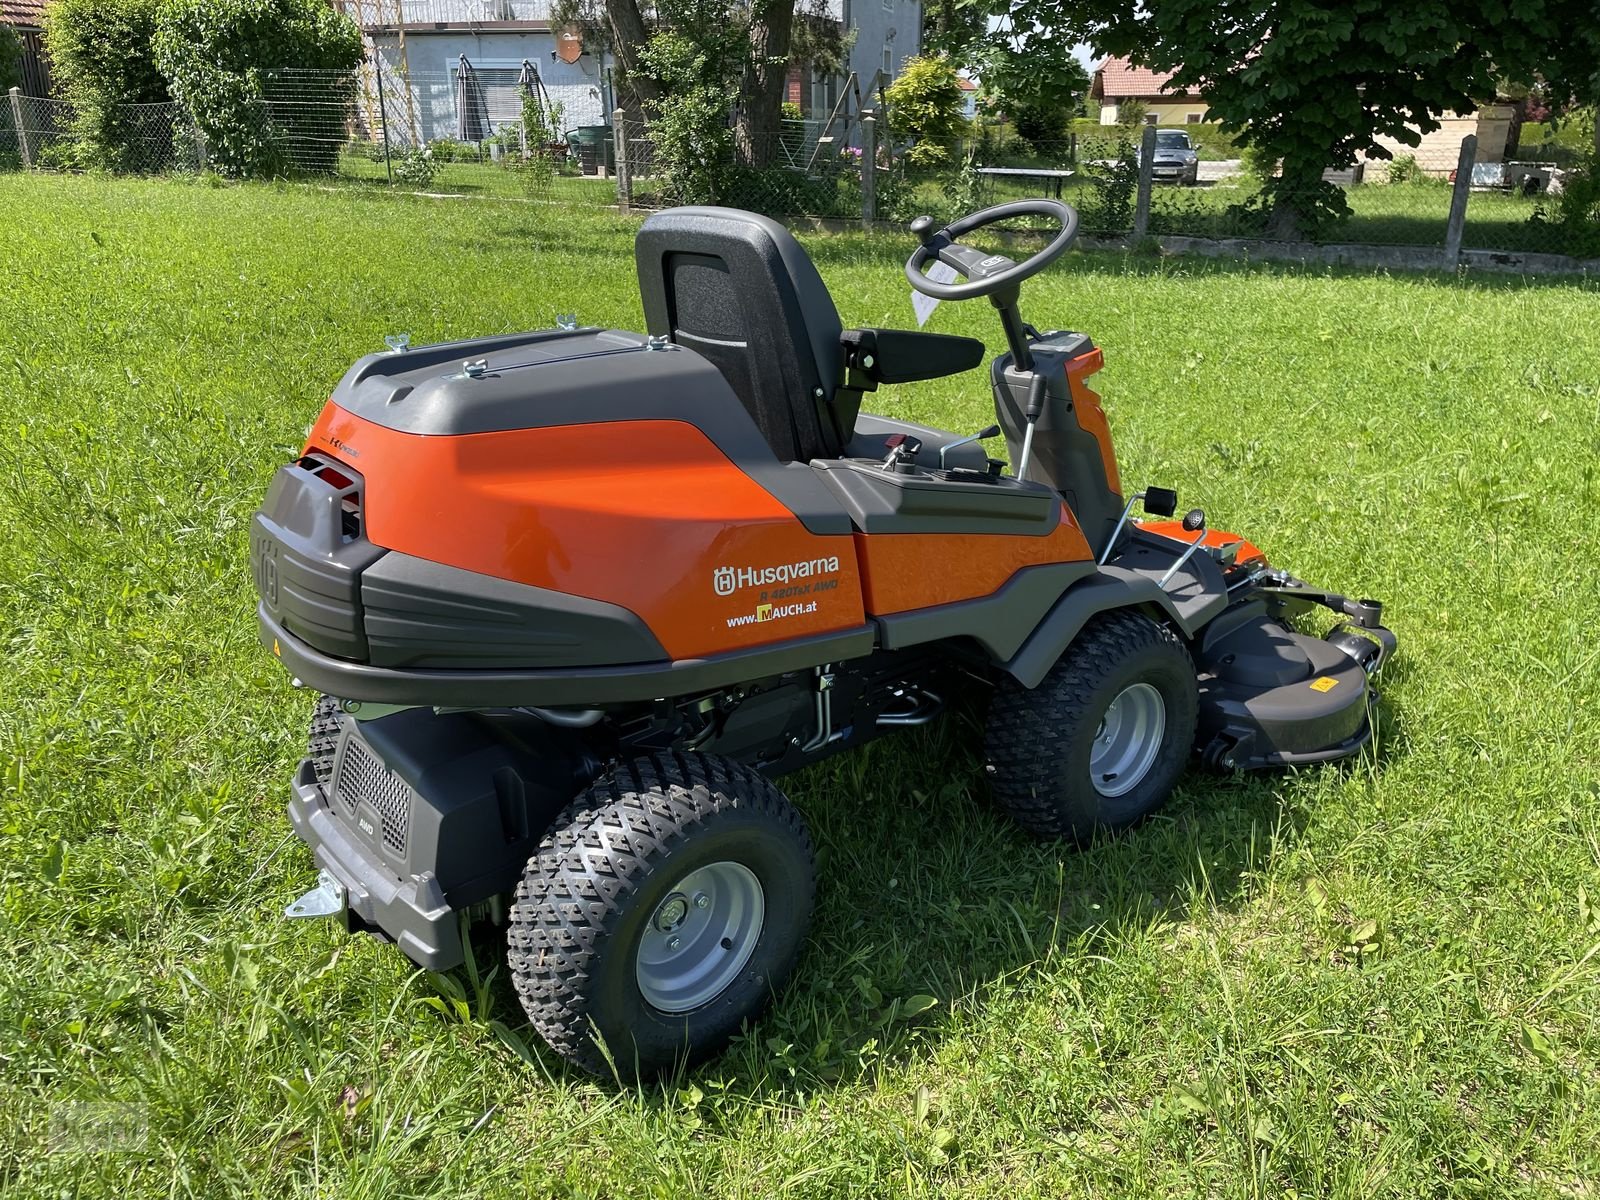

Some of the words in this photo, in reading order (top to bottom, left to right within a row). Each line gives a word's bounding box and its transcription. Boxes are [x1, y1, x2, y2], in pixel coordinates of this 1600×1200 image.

[737, 556, 839, 588] Husqvarna
[814, 579, 838, 592] AWD
[726, 600, 818, 628] www.MAUCH.at
[358, 818, 374, 835] AWD
